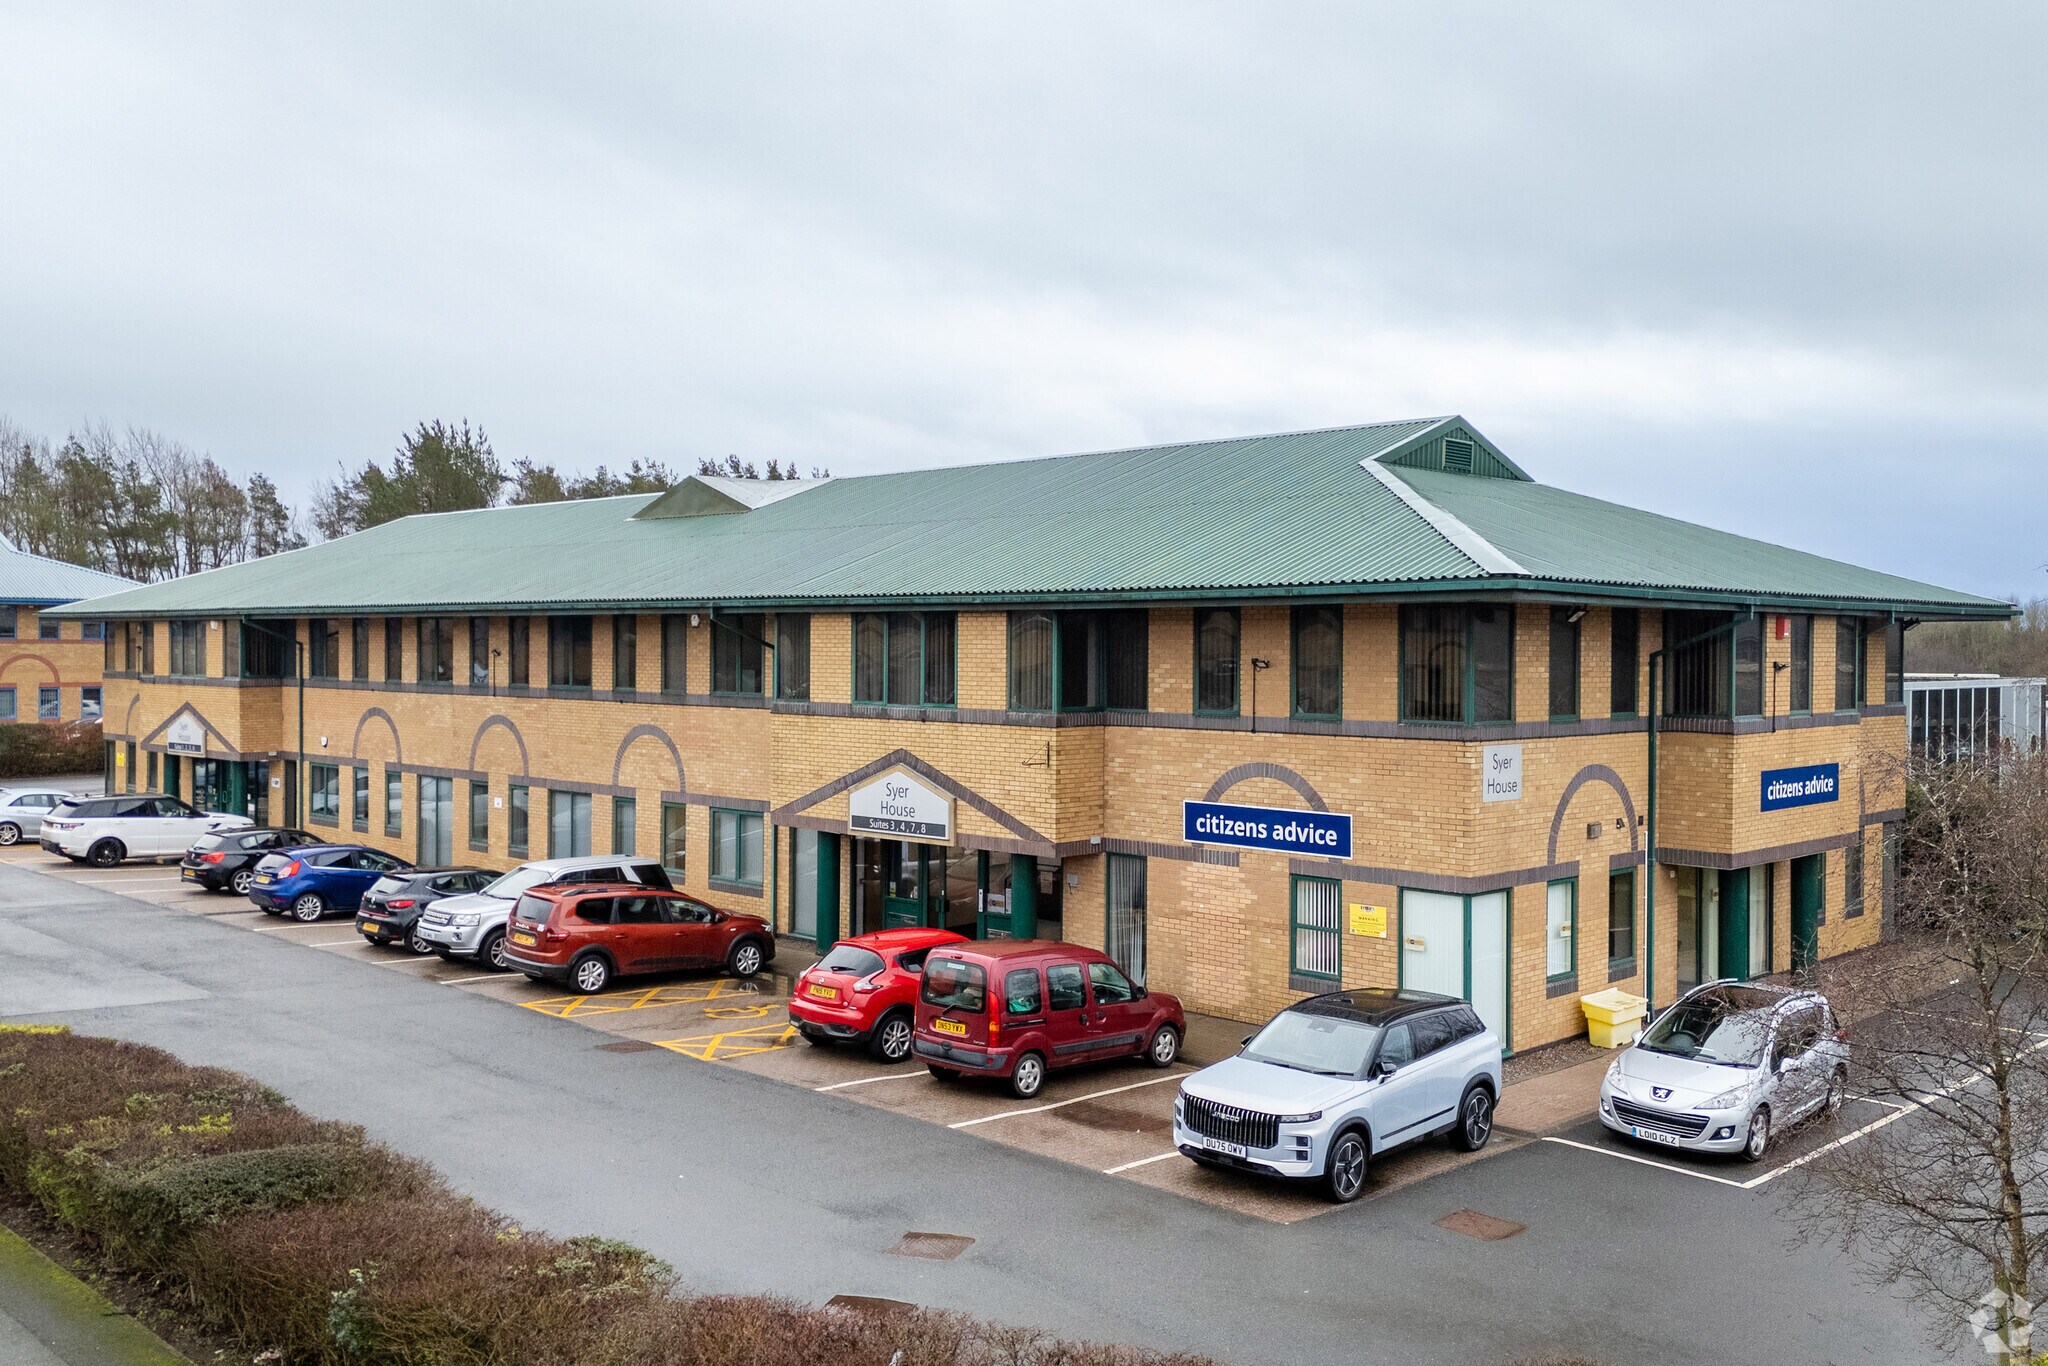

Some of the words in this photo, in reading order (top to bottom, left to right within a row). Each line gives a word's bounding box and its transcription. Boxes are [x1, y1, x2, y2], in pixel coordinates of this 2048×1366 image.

[1493, 753, 1513, 774] Syer
[886, 782, 909, 801] Syer
[1487, 778, 1518, 794] House
[1767, 780, 1803, 800] citizens
[1805, 774, 1834, 795] advice
[880, 801, 916, 818] House
[869, 818, 889, 830] Suites
[1195, 813, 1268, 839] citizens
[1272, 821, 1338, 846] advice
[1206, 1138, 1226, 1153] DU75
[1659, 1134, 1676, 1145] GLZ
